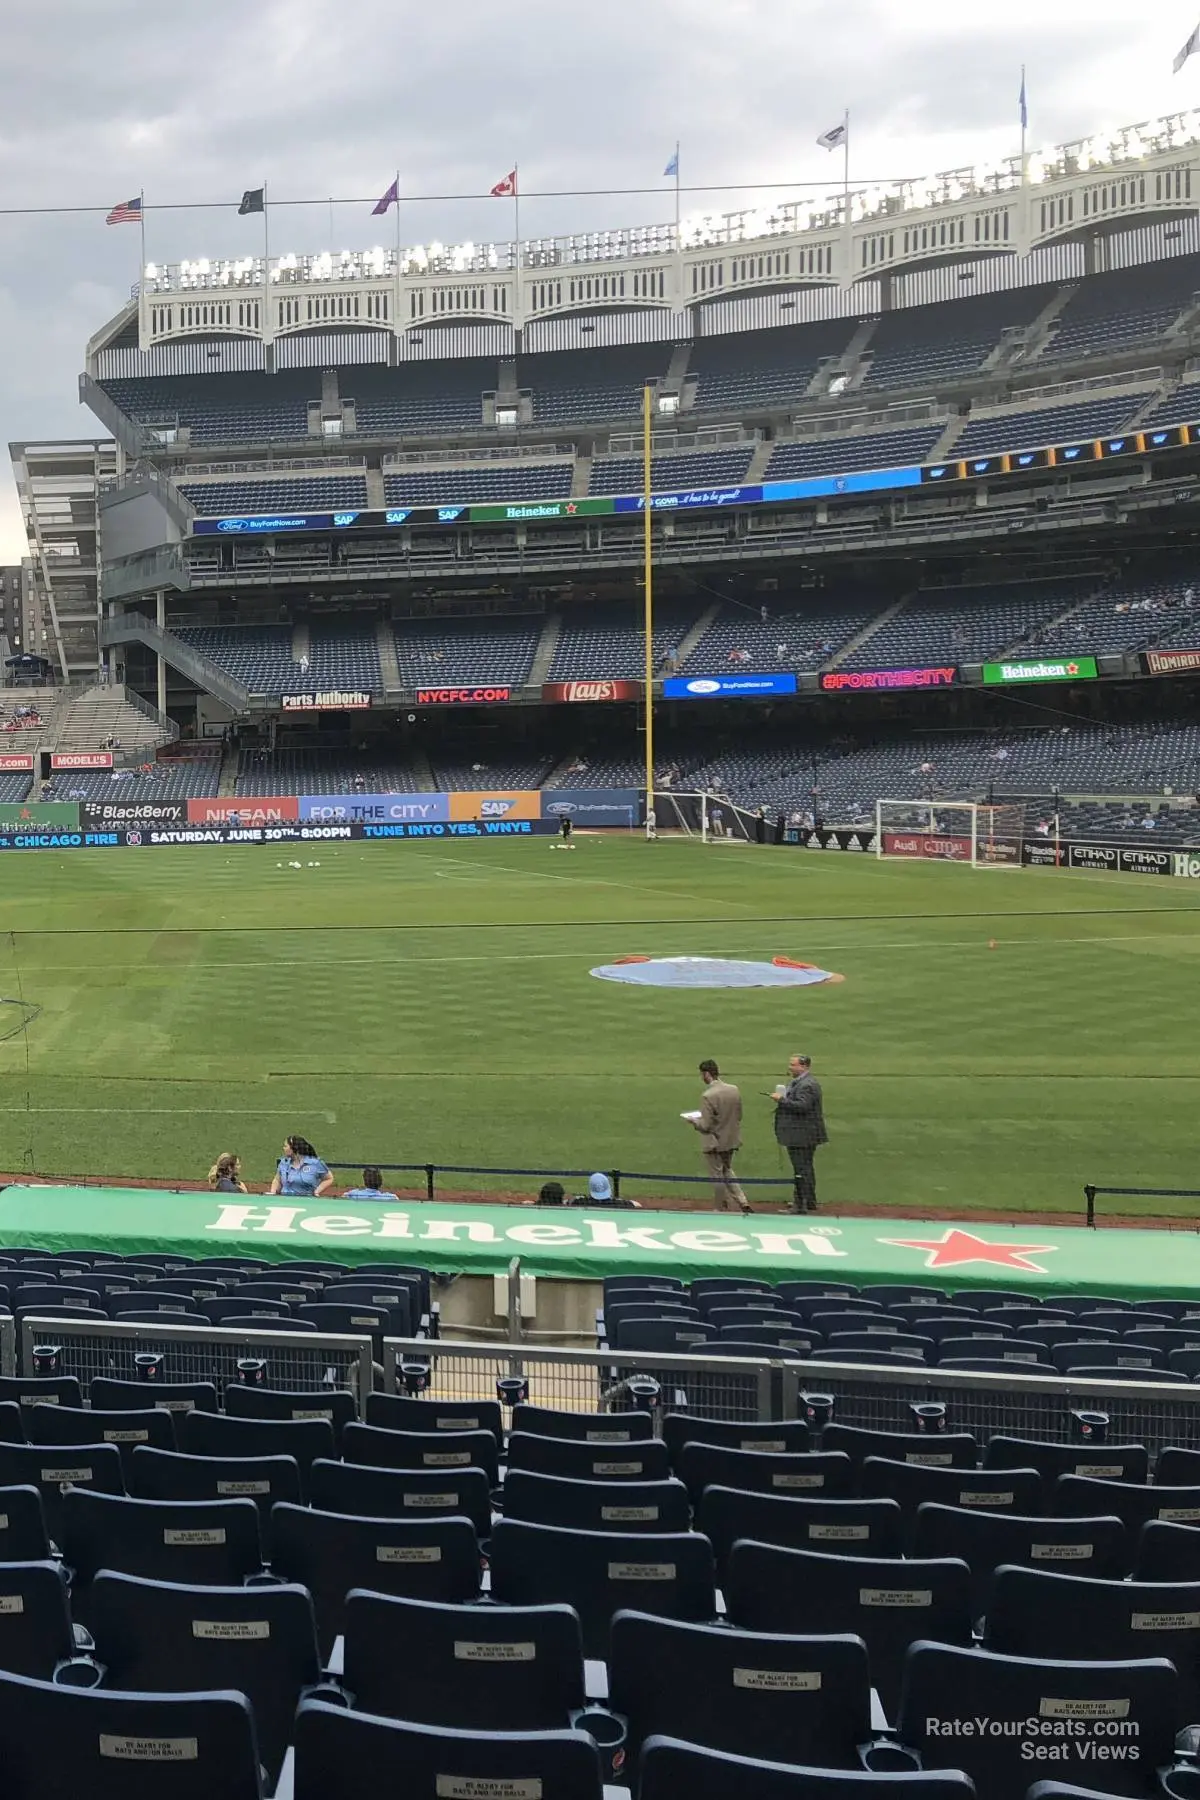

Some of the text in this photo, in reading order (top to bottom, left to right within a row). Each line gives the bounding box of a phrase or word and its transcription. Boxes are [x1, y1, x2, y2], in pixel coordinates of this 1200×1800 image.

[386, 512, 406, 524] SAP
[438, 510, 459, 521] SAP
[507, 505, 560, 518] Heineken
[249, 518, 307, 528] BuyFordNow.com
[334, 514, 354, 526] SAP
[822, 668, 957, 689] #FORTHECITY
[1001, 664, 1065, 680] Heineken
[282, 691, 370, 707] Parts Authority
[418, 689, 509, 703] NYCFC.COM
[57, 755, 107, 765] MODELL'S
[102, 805, 181, 820] BlackBerry
[310, 804, 429, 819] FOR THE CITY
[481, 800, 510, 816] SAP
[14, 834, 82, 846] CHICAGO
[85, 833, 118, 845] FIRE
[151, 830, 224, 843] SATURDAY,
[227, 829, 262, 841] JUNE
[363, 825, 405, 837] TUNE
[408, 824, 446, 835] INTO
[449, 822, 481, 836] YES,
[484, 821, 531, 833] WNYE
[893, 839, 918, 851] Audi
[1074, 848, 1115, 860] ETIHAD
[1122, 852, 1167, 864] ETIHAD
[1130, 865, 1160, 874] AIRWAYS
[205, 1203, 847, 1257] Heineken
